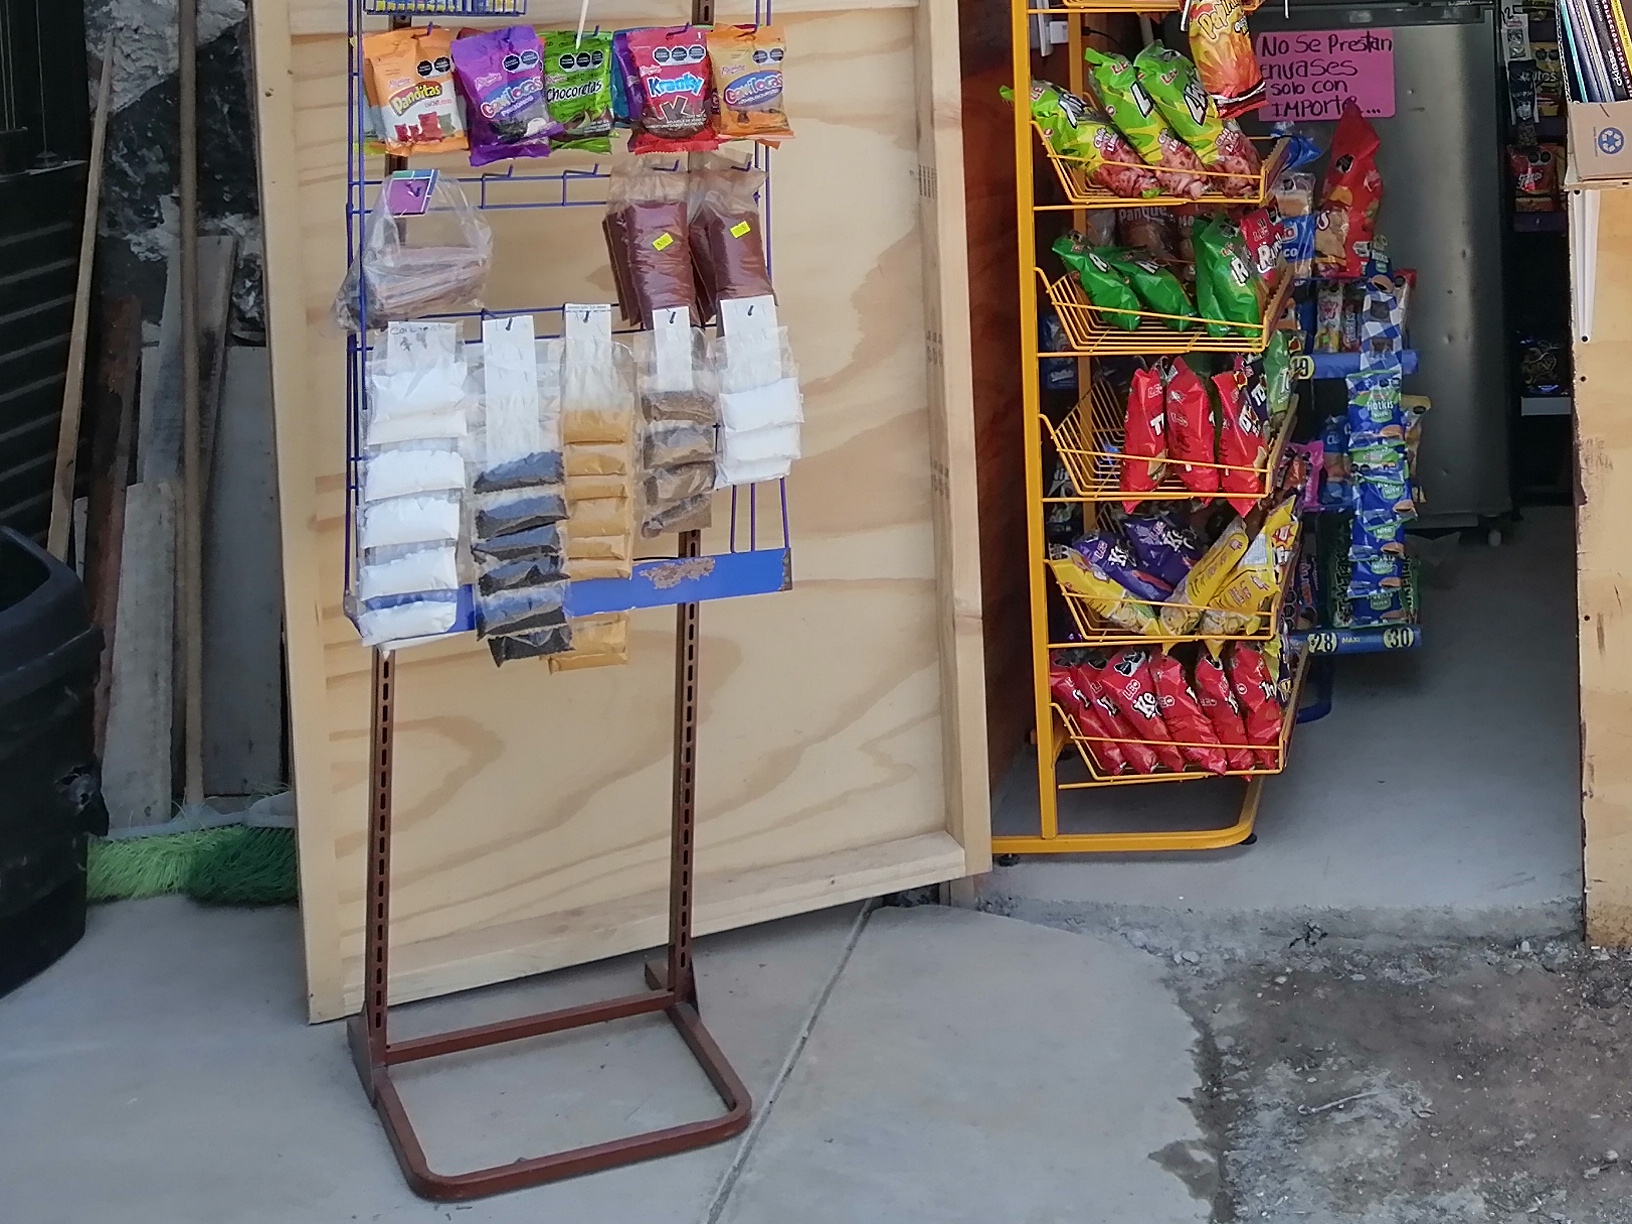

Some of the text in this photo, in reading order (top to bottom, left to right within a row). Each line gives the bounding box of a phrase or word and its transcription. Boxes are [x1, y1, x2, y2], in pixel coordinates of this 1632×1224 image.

[1262, 31, 1392, 57] No Se Prestan
[546, 80, 602, 104] Chocoretas
[648, 72, 705, 97] Kranky
[1271, 80, 1348, 96] solo con
[393, 83, 442, 115] Panditas
[1122, 679, 1140, 699] LEO
